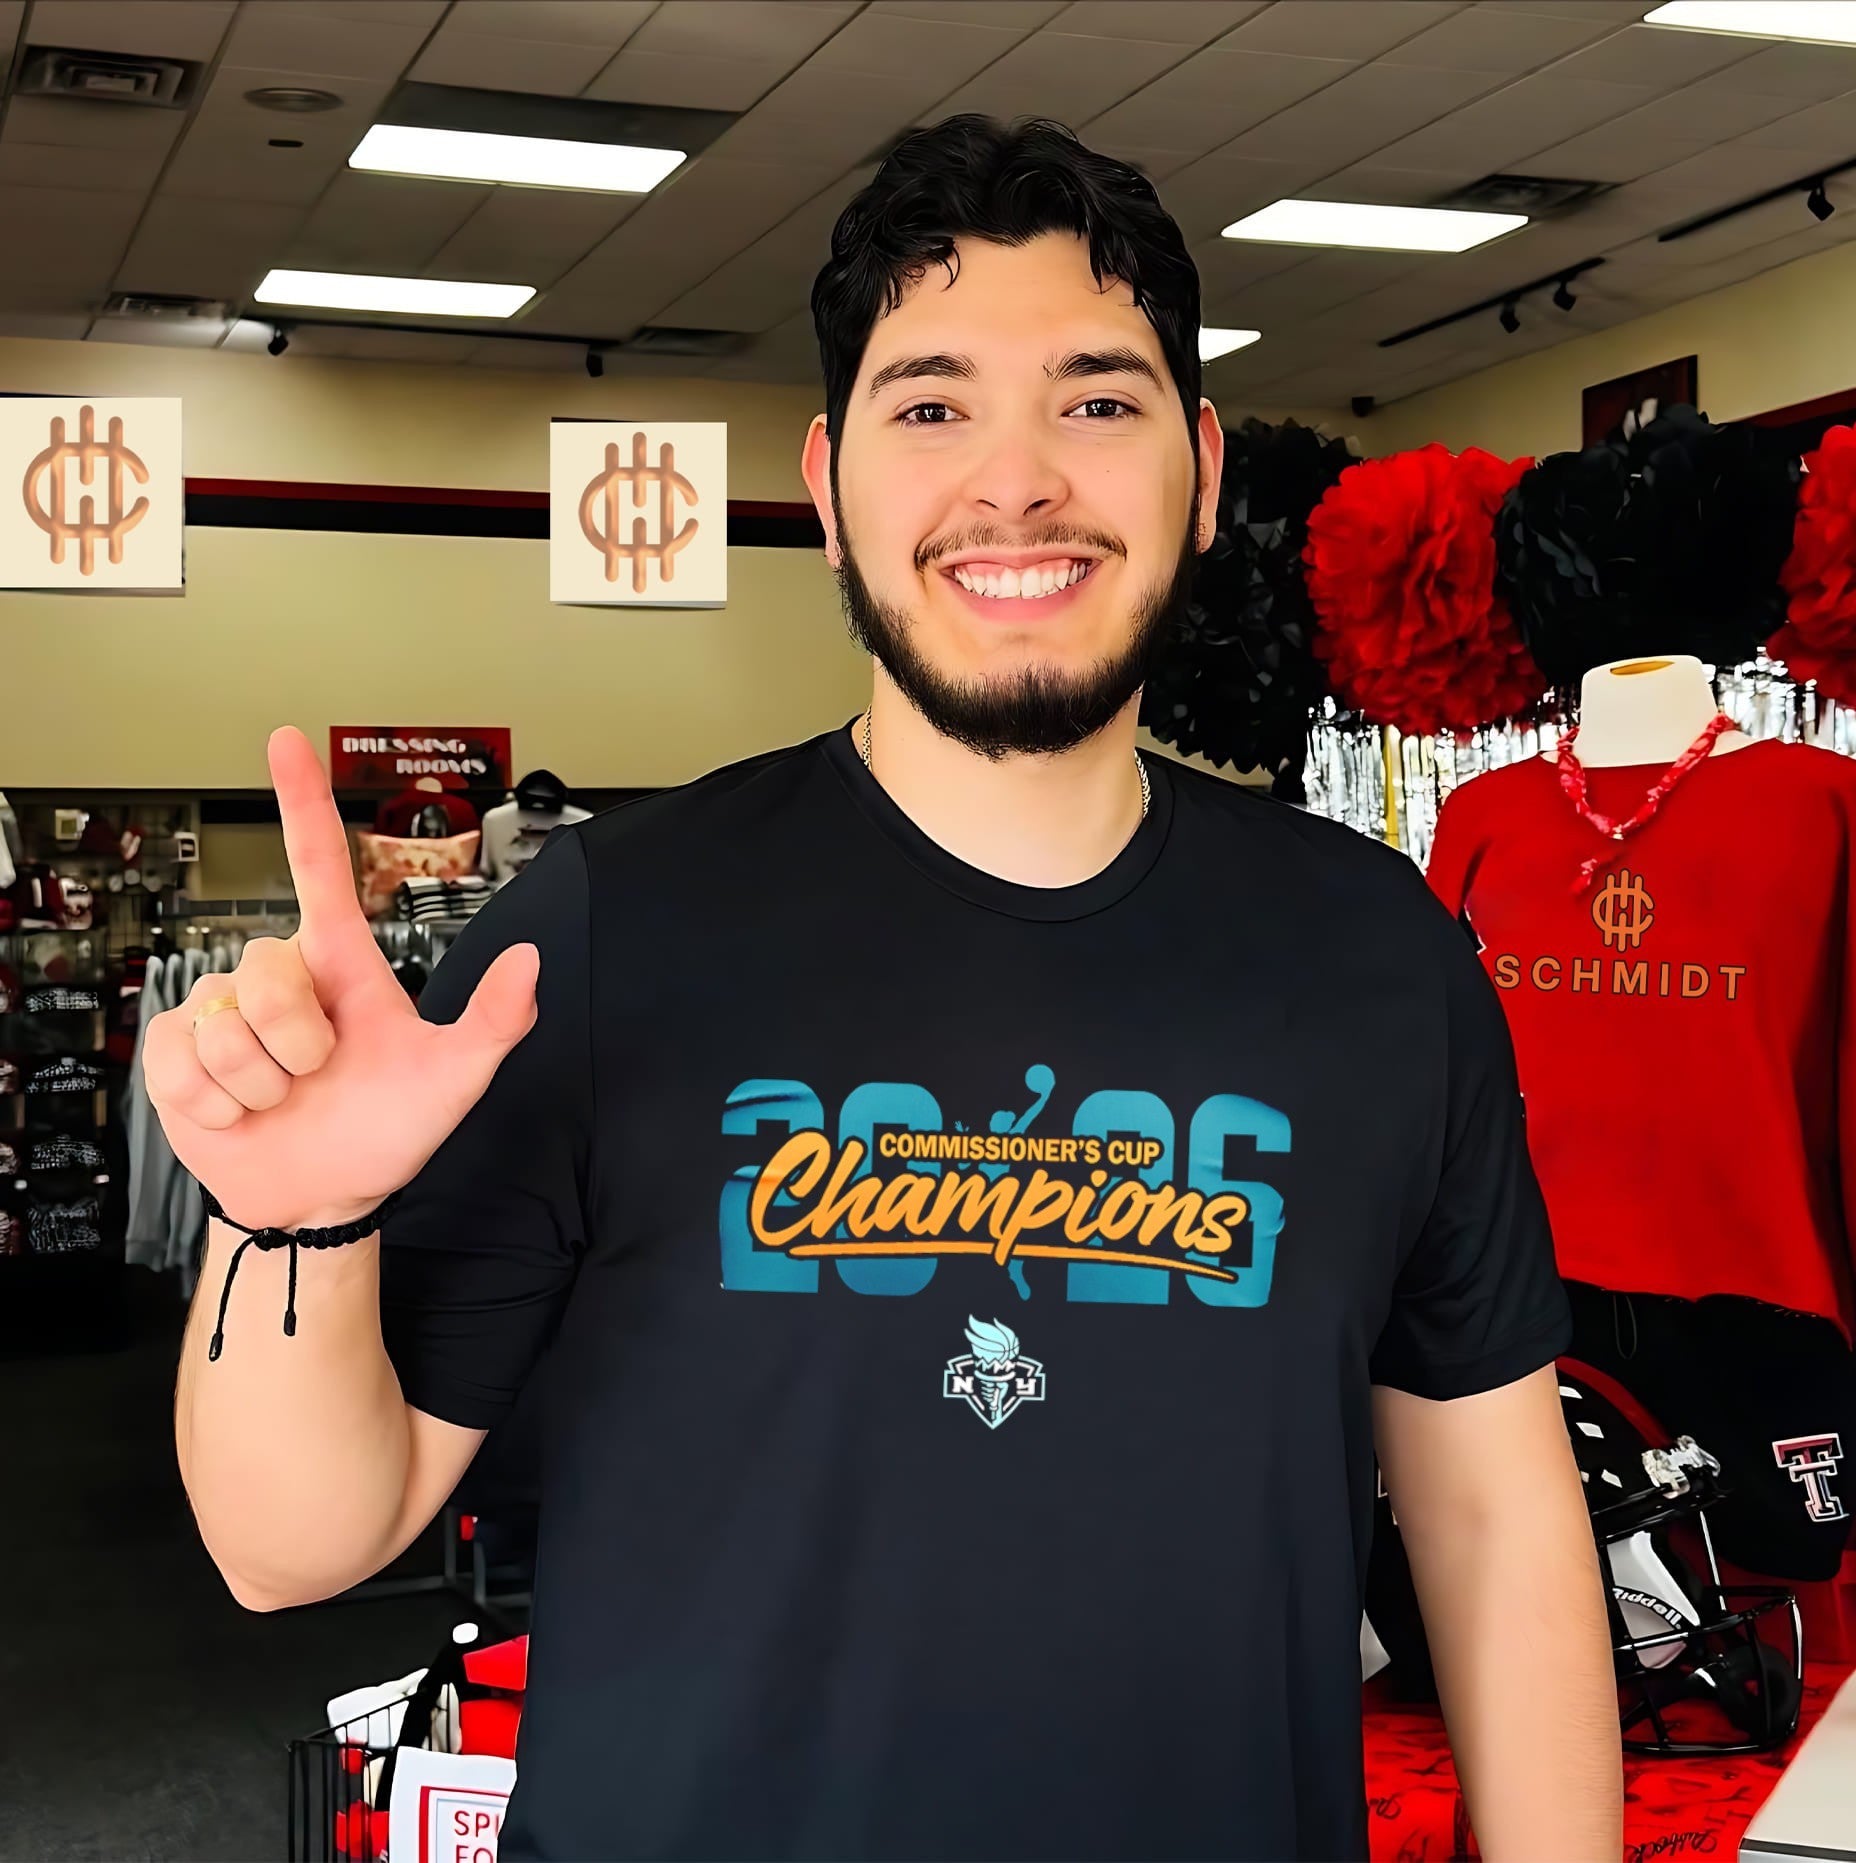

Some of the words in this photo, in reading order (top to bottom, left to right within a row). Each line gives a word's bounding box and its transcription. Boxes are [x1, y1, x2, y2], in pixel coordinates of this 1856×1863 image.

[396, 758, 487, 774] ROOMS
[1494, 954, 1746, 1000] SCHMIDT
[879, 1132, 1101, 1163] COMMISSIONER’S
[1107, 1140, 1160, 1165] CUP
[751, 1131, 1247, 1265] Champions
